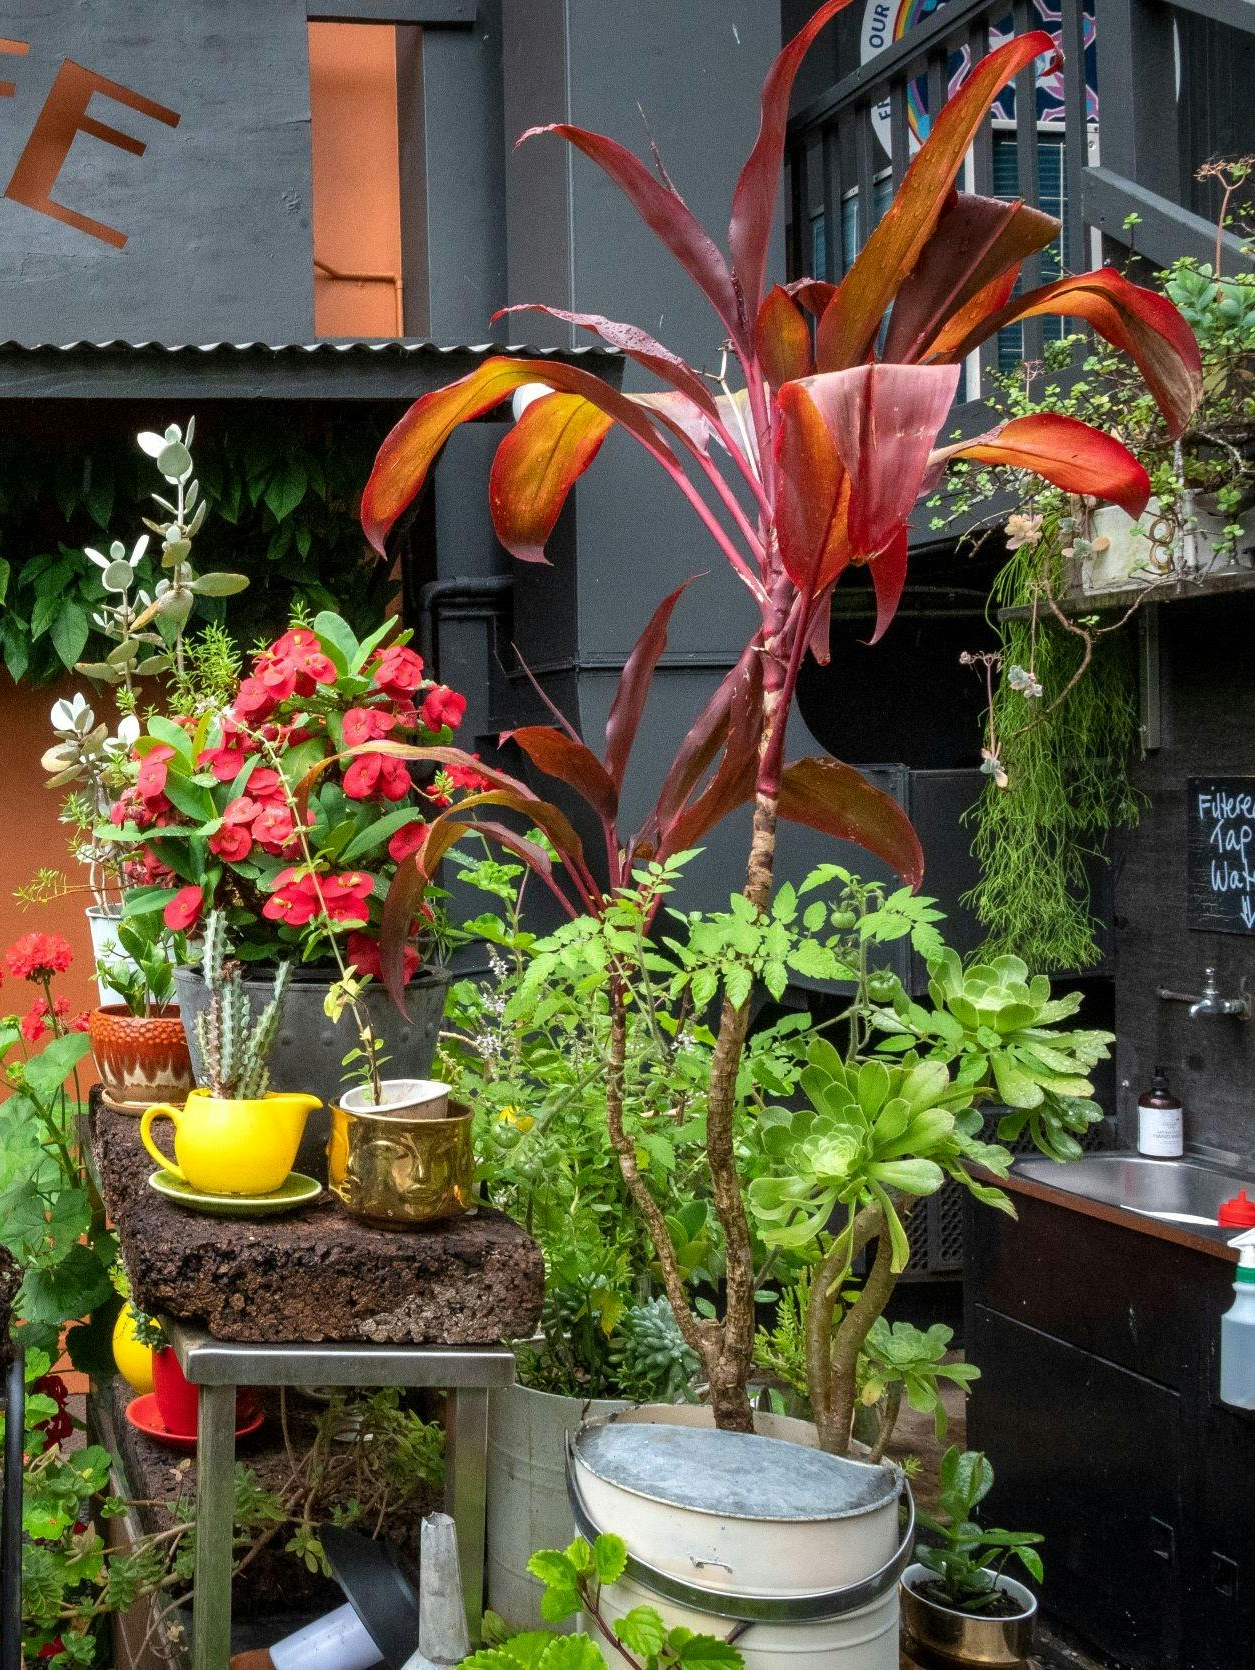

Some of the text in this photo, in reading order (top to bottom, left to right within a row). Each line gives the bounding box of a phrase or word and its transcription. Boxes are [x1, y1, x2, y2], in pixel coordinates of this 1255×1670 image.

[868, 4, 890, 48] OUR
[1198, 786, 1255, 820] Filtere
[1210, 819, 1252, 863] Tap
[1211, 859, 1255, 892] Wat
